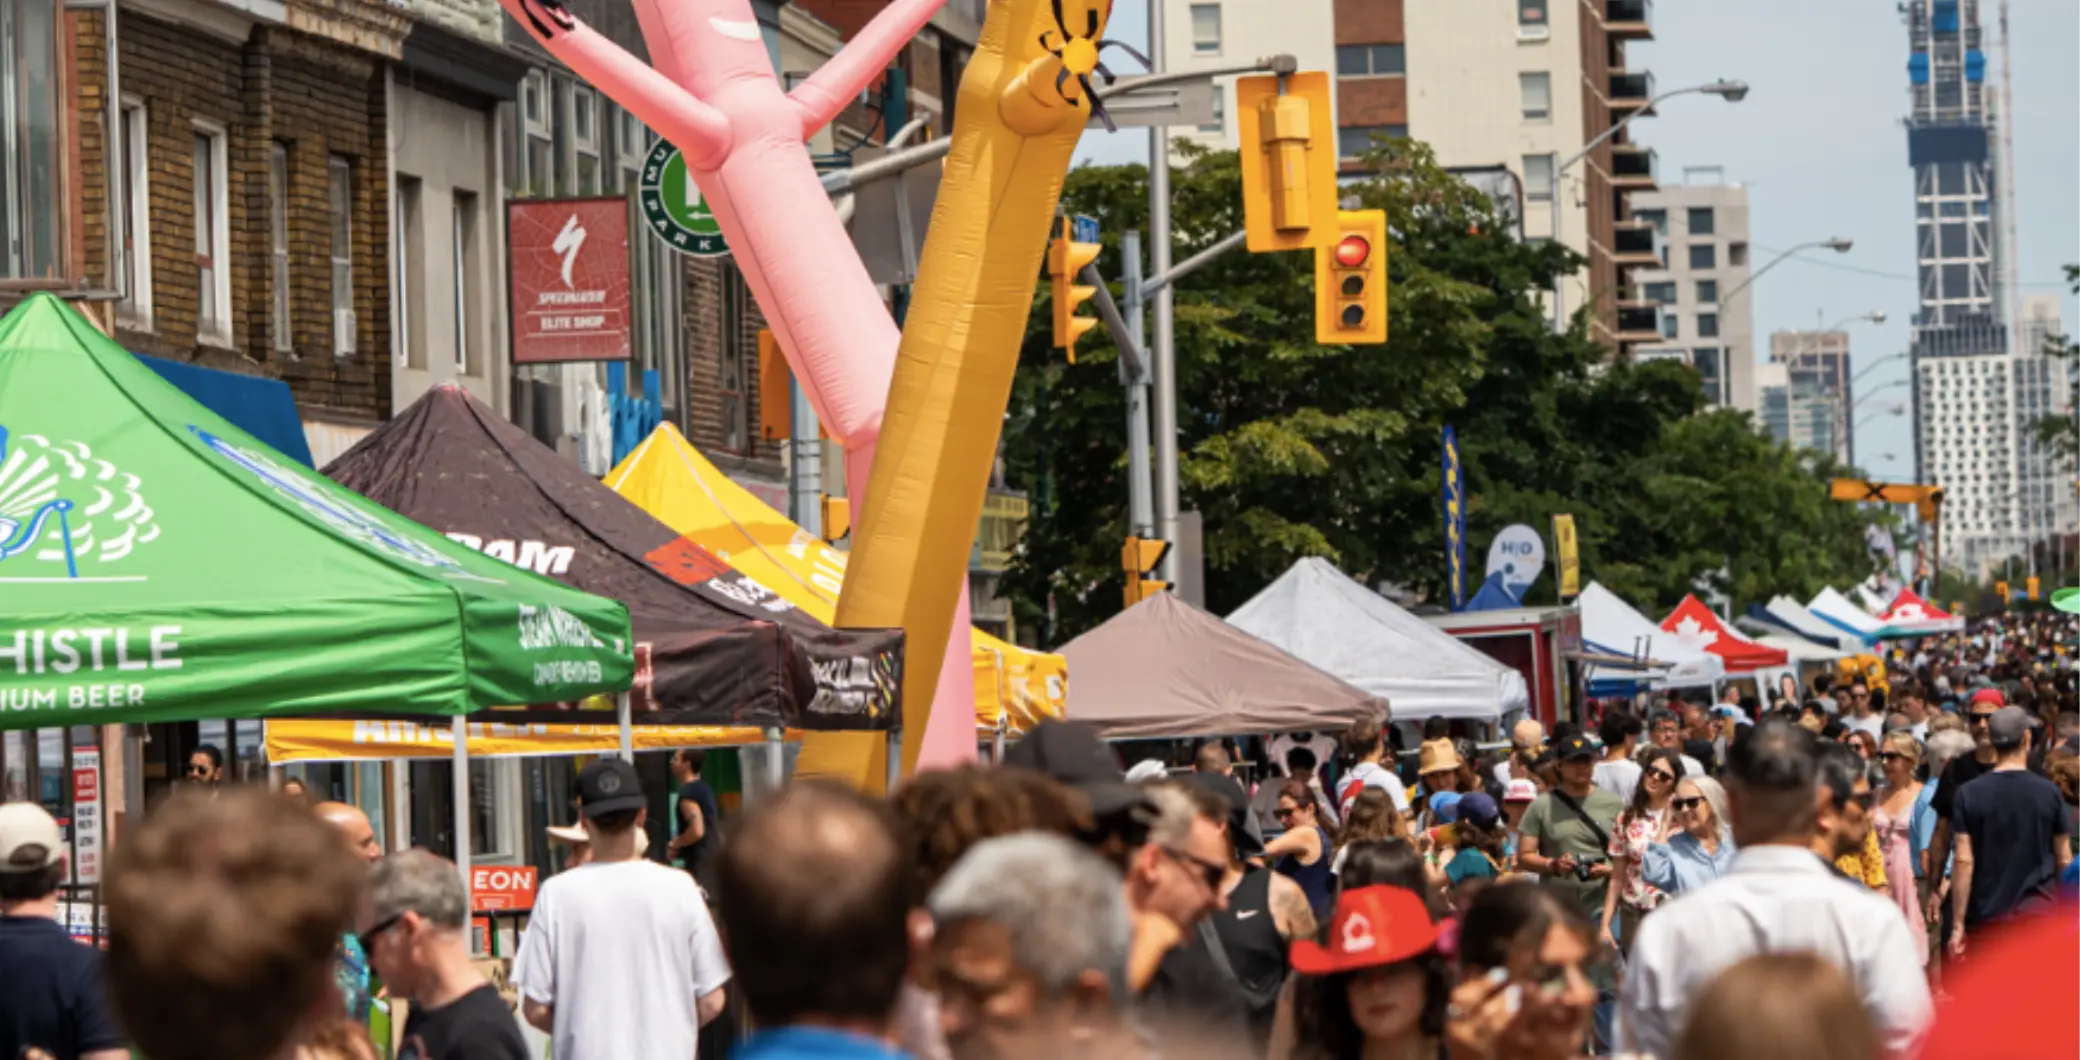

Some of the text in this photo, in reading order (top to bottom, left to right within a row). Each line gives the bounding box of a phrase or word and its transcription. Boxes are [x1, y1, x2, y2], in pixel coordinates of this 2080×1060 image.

[541, 314, 605, 331] ELITE SHOP
[68, 683, 145, 709] BEER
[474, 870, 531, 890] EON
